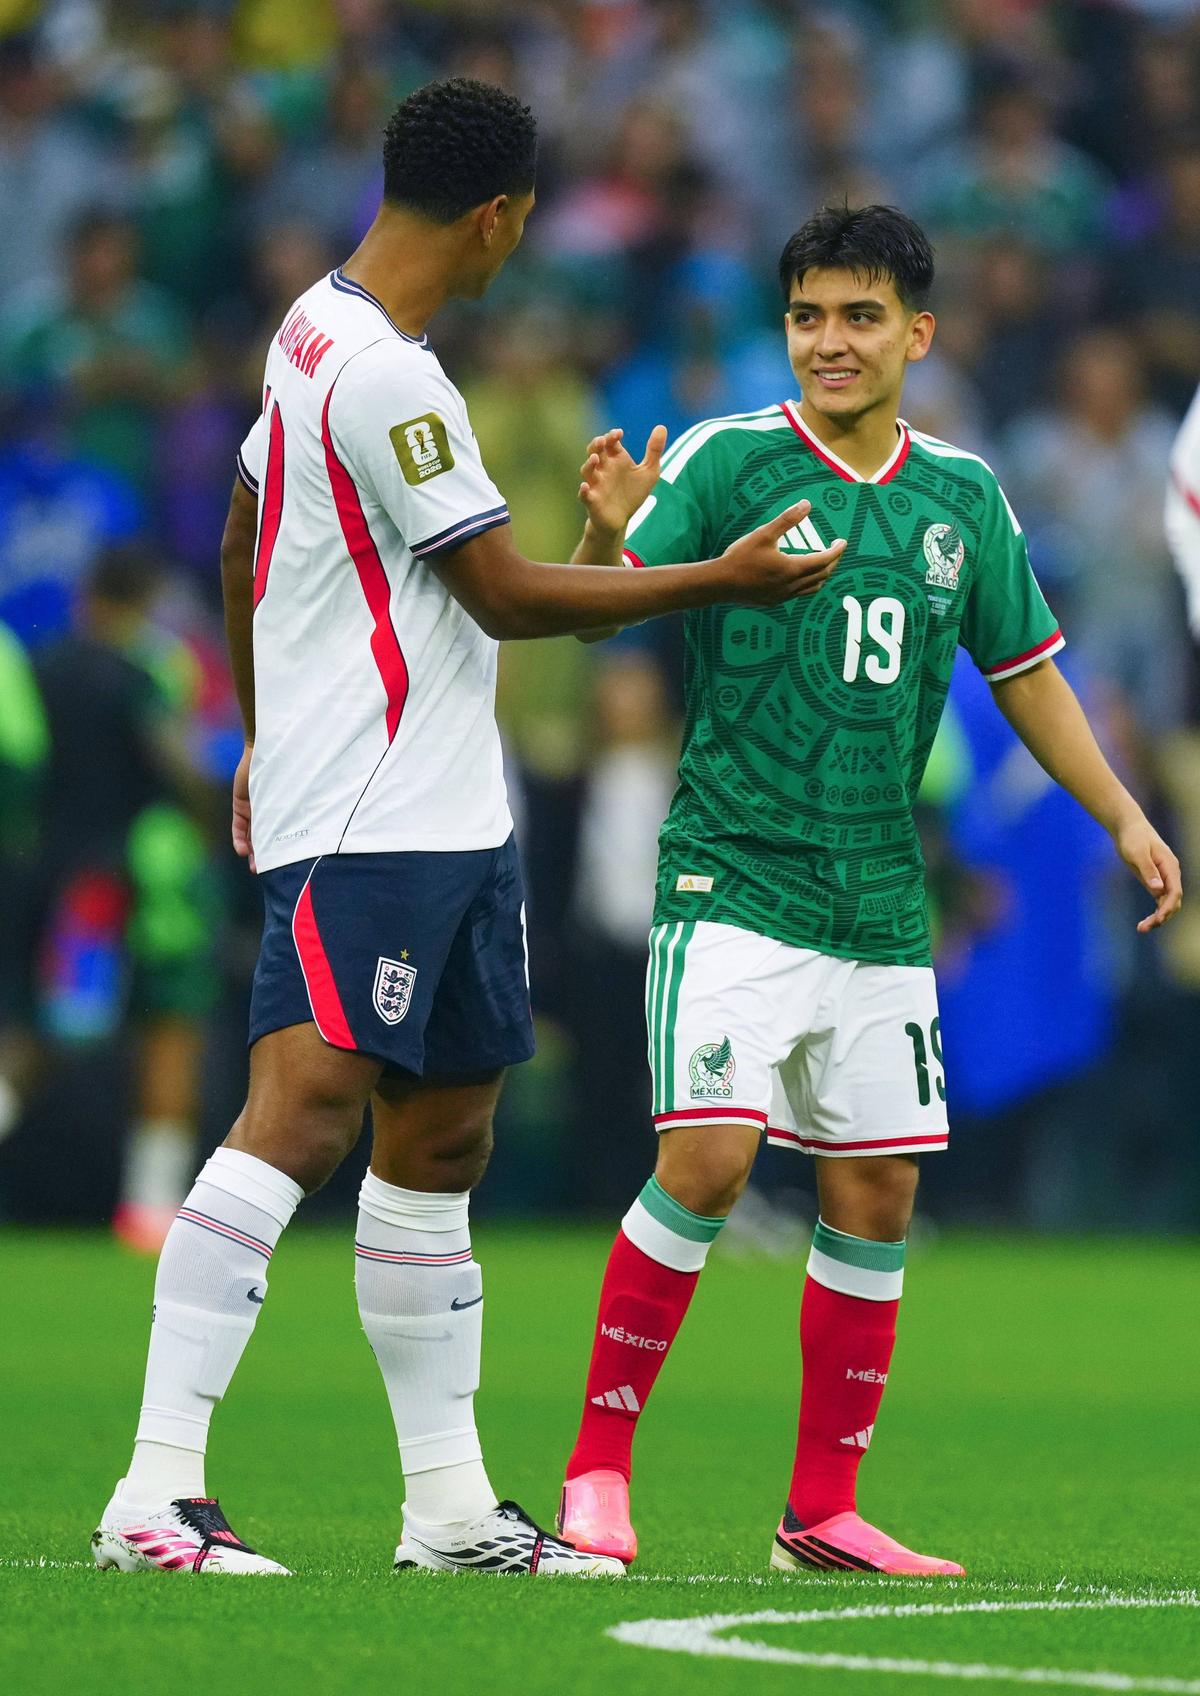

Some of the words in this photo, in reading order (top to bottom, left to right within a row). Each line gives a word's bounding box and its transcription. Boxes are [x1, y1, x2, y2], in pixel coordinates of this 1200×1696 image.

[419, 464, 442, 478] 2026
[842, 595, 906, 684] 19
[601, 1322, 668, 1352] MÉXICO
[846, 1369, 888, 1384] MÉXI
